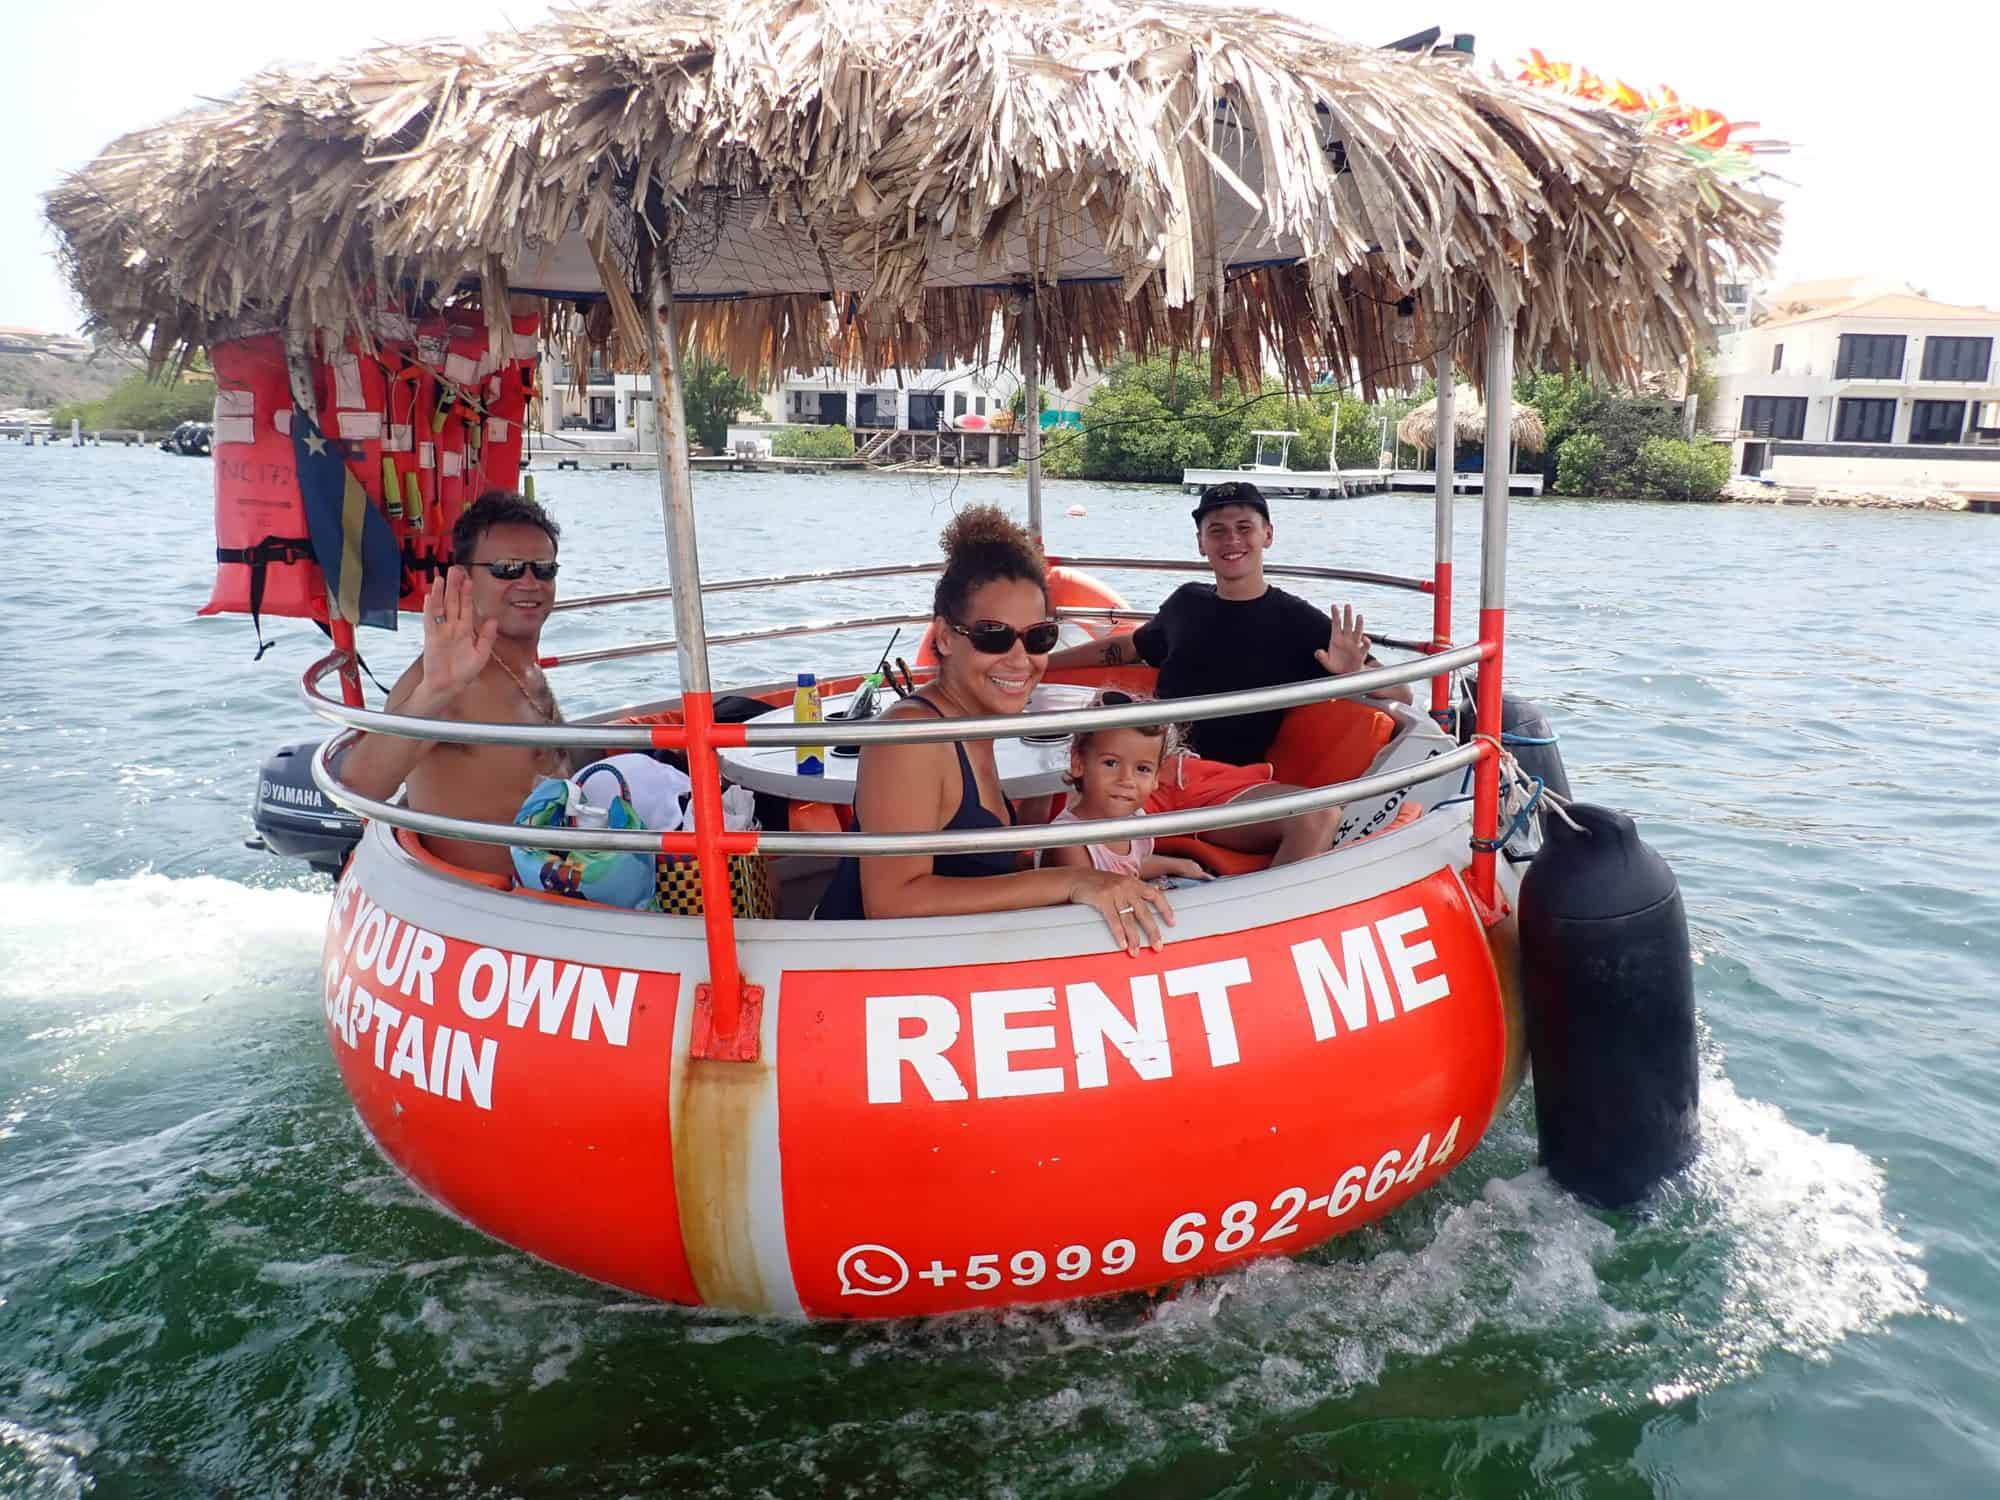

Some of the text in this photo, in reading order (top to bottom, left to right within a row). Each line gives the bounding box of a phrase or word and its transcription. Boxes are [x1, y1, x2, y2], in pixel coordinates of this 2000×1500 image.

[271, 783, 322, 807] YAMAHA
[325, 959, 498, 1111] CAPTAIN
[344, 891, 446, 1006] YOUR
[458, 947, 640, 1047] OWN
[865, 907, 1451, 1104] RENT ME
[918, 1116, 1463, 1292] +5999 682-6644
